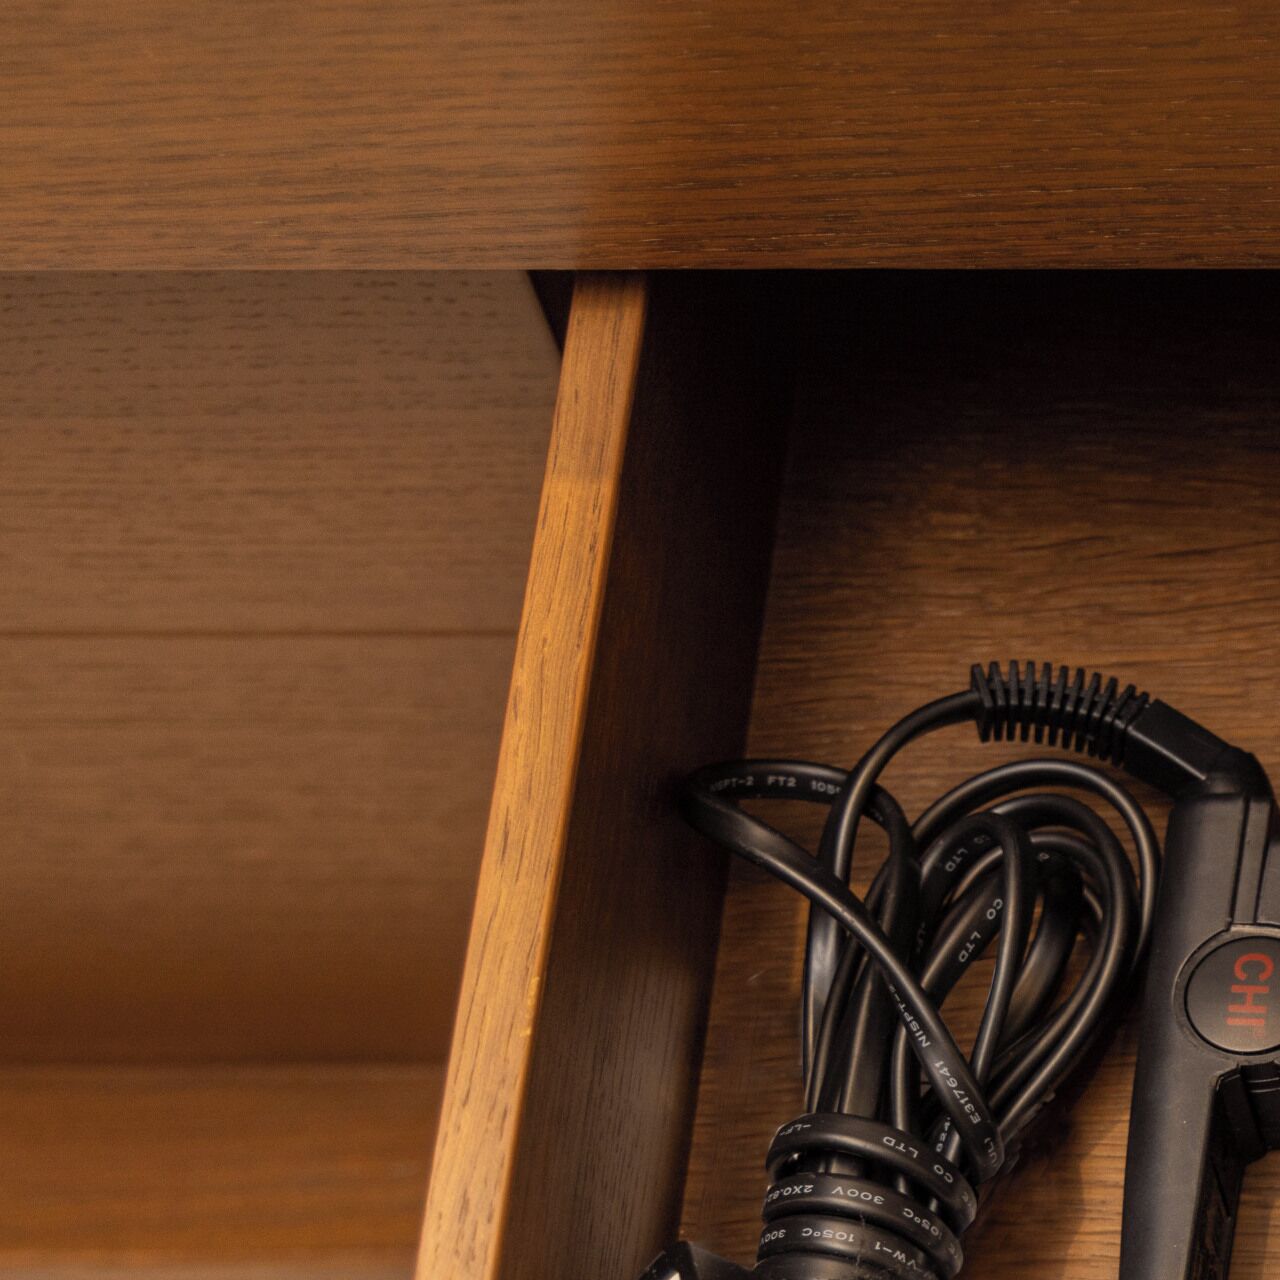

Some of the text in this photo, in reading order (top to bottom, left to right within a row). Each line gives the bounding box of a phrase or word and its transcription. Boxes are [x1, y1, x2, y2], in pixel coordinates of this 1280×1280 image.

[767, 775, 797, 788] FT2
[958, 898, 1004, 963] CO LTD
[933, 1060, 981, 1125] E317641
[883, 1136, 919, 1159] LTD
[933, 1164, 954, 1184] CO
[831, 1186, 885, 1205] 300V
